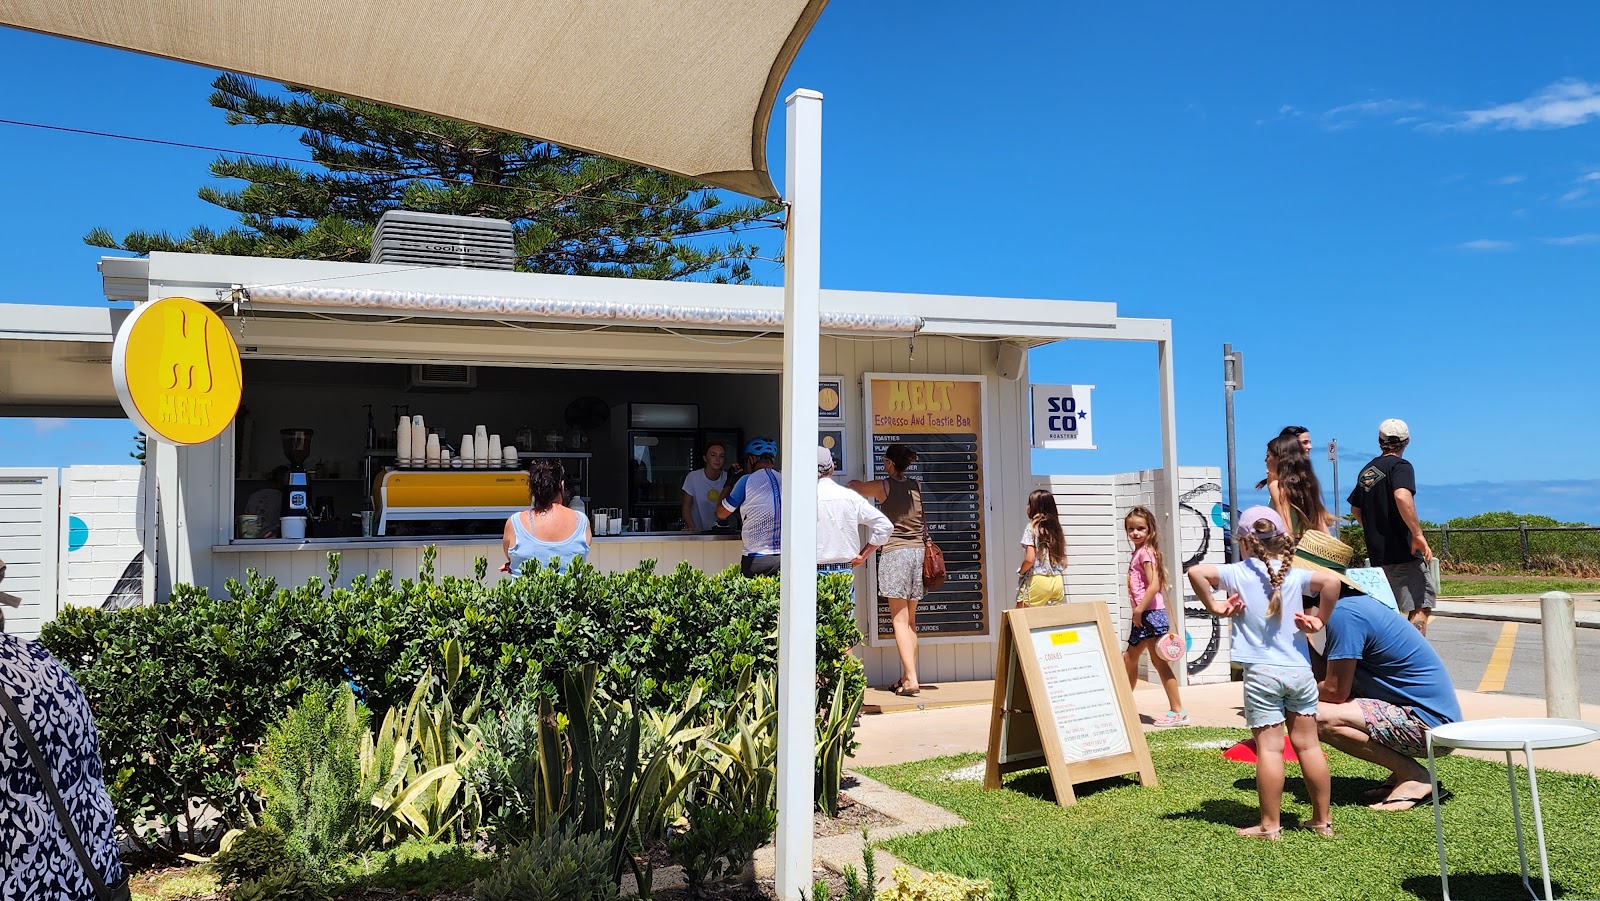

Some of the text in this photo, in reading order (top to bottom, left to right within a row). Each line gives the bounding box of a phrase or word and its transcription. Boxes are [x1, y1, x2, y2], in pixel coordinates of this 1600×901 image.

[425, 245, 475, 253] coolair
[889, 380, 956, 412] MELT
[160, 394, 213, 427] MELT
[1047, 397, 1076, 412] SO
[1048, 416, 1077, 431] CO
[1044, 653, 1063, 661] COOKIES
